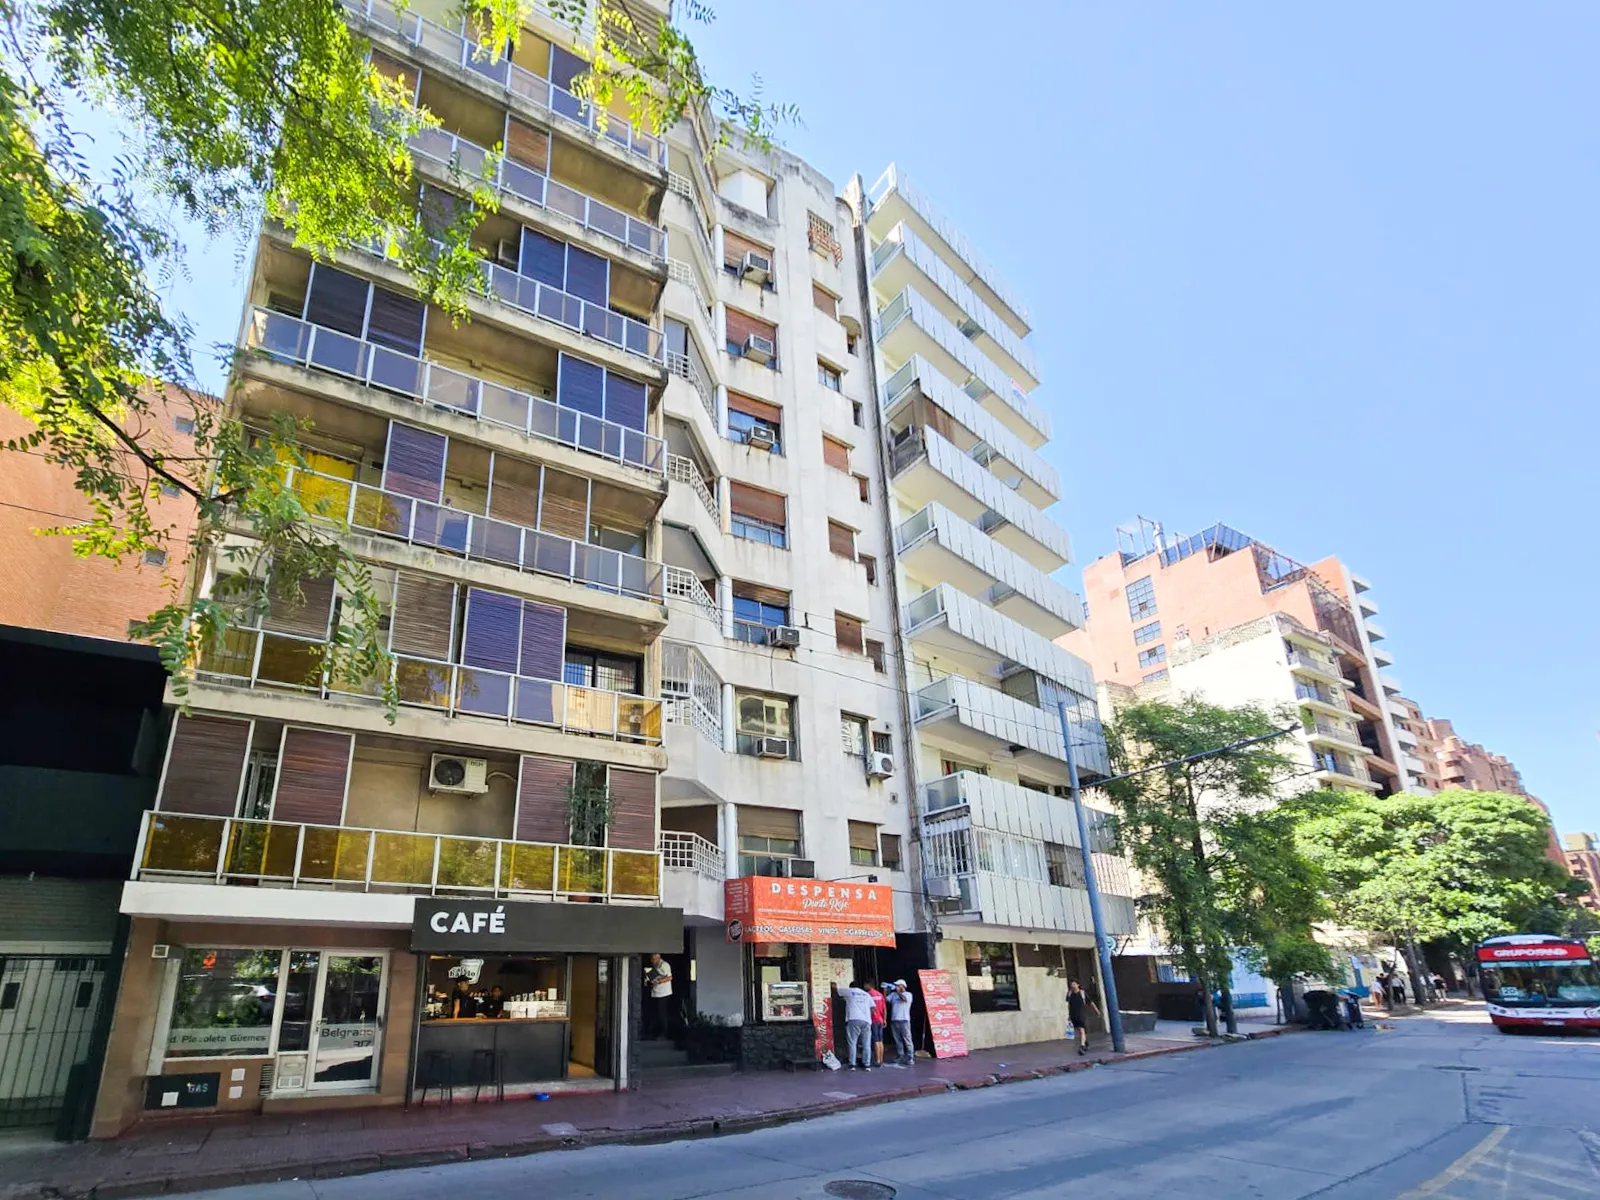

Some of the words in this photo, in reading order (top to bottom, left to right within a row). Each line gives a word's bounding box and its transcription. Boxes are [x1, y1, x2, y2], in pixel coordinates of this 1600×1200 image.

[771, 882, 877, 900] DESPENSA
[802, 898, 828, 909] Punto
[430, 905, 506, 934] CAFÉ
[818, 927, 839, 935] VINOS
[188, 1083, 208, 1093] GAS
